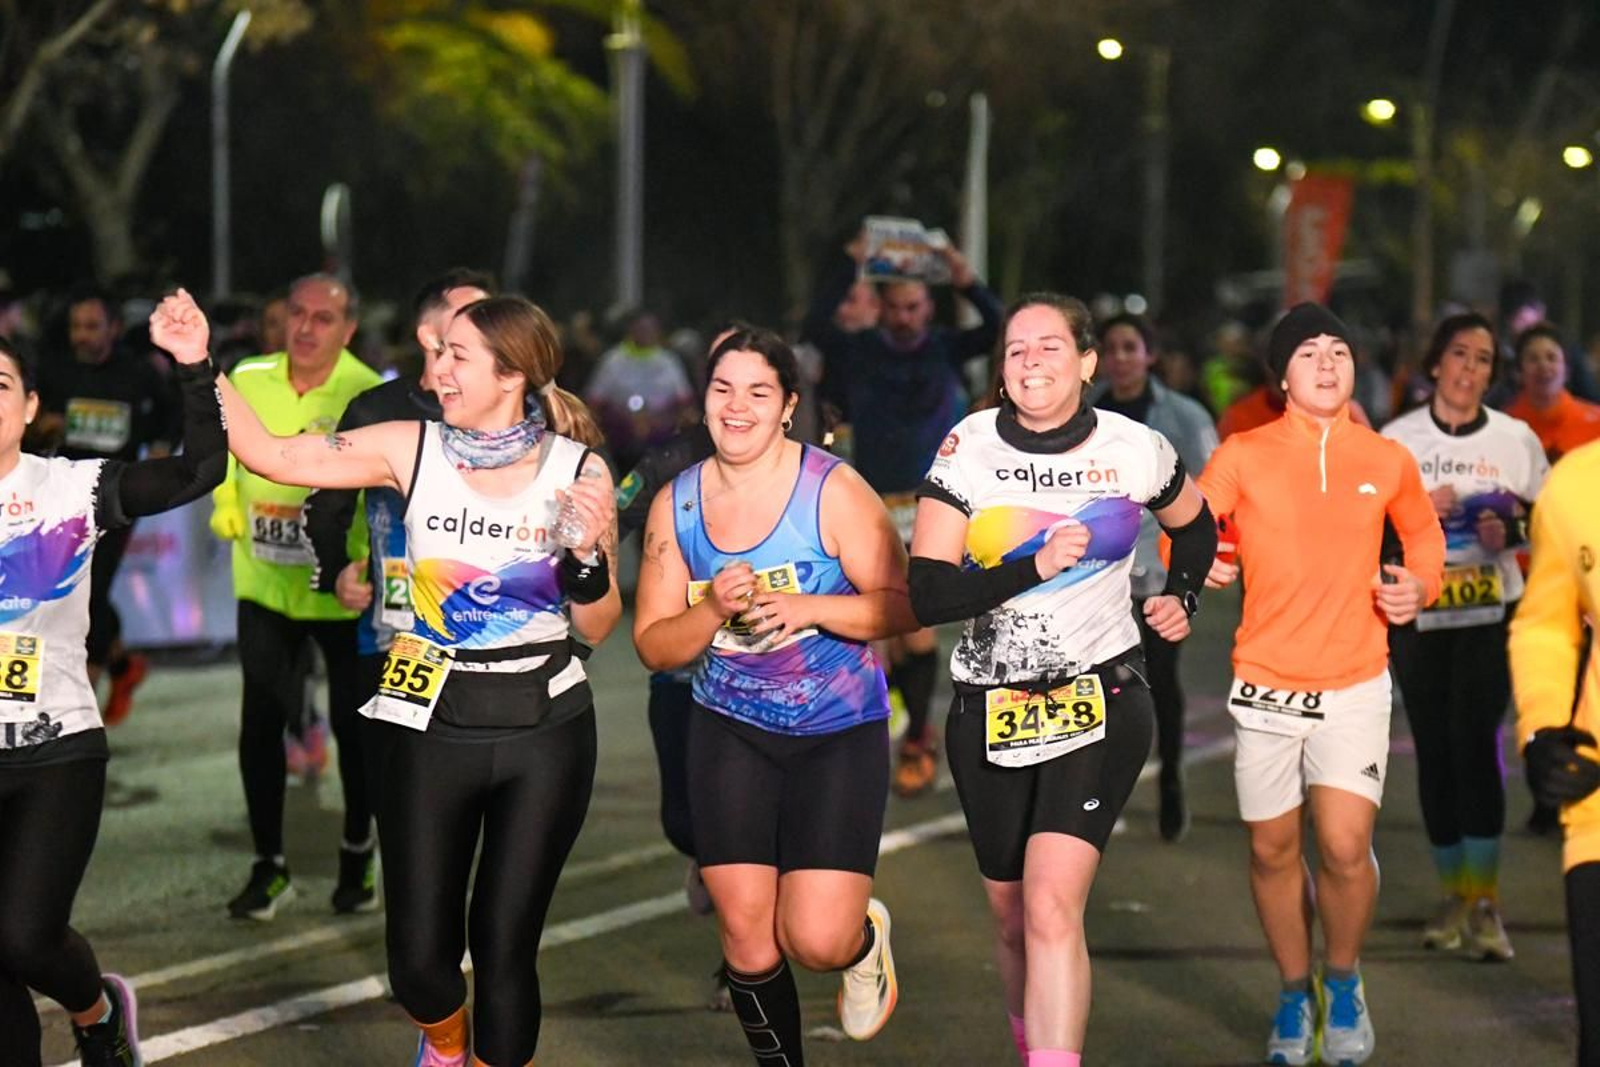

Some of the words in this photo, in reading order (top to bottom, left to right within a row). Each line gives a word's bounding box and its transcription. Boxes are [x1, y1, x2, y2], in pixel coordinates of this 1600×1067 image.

[995, 459, 1118, 492] calderón
[1420, 453, 1499, 481] alderón
[426, 507, 547, 544] calderón
[0, 659, 28, 690] 8
[997, 701, 1096, 739] 3458
